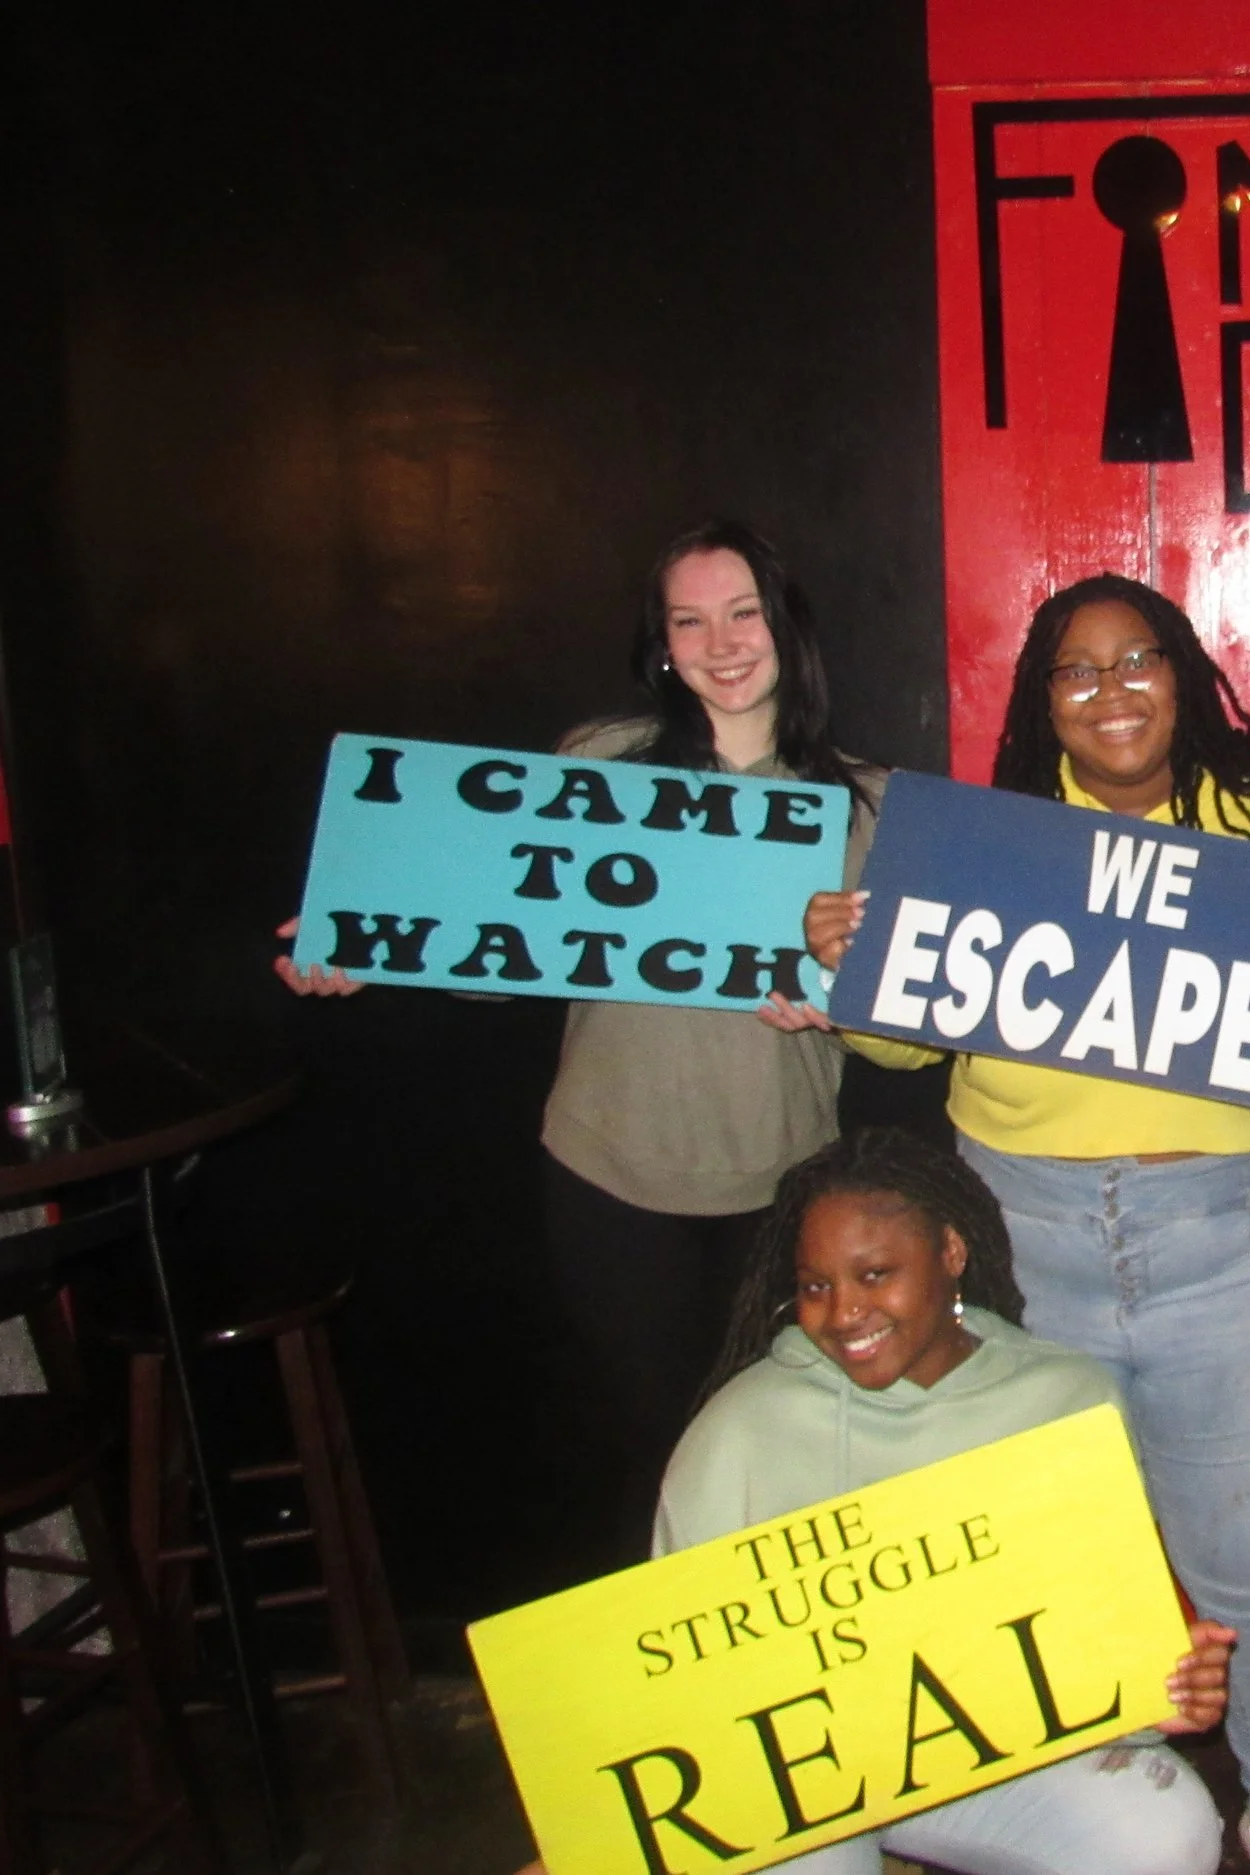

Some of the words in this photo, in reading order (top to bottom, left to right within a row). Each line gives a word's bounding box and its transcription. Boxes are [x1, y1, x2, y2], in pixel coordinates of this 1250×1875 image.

[354, 748, 405, 804] I
[457, 760, 824, 846] CAME
[510, 843, 659, 907] TO
[1086, 829, 1200, 930] WE
[326, 911, 809, 1001] WATCH
[734, 1502, 875, 1582] THE
[635, 1513, 1001, 1680] STRUGGLE
[811, 1616, 868, 1674] IS
[597, 1608, 1121, 1875] REAL
